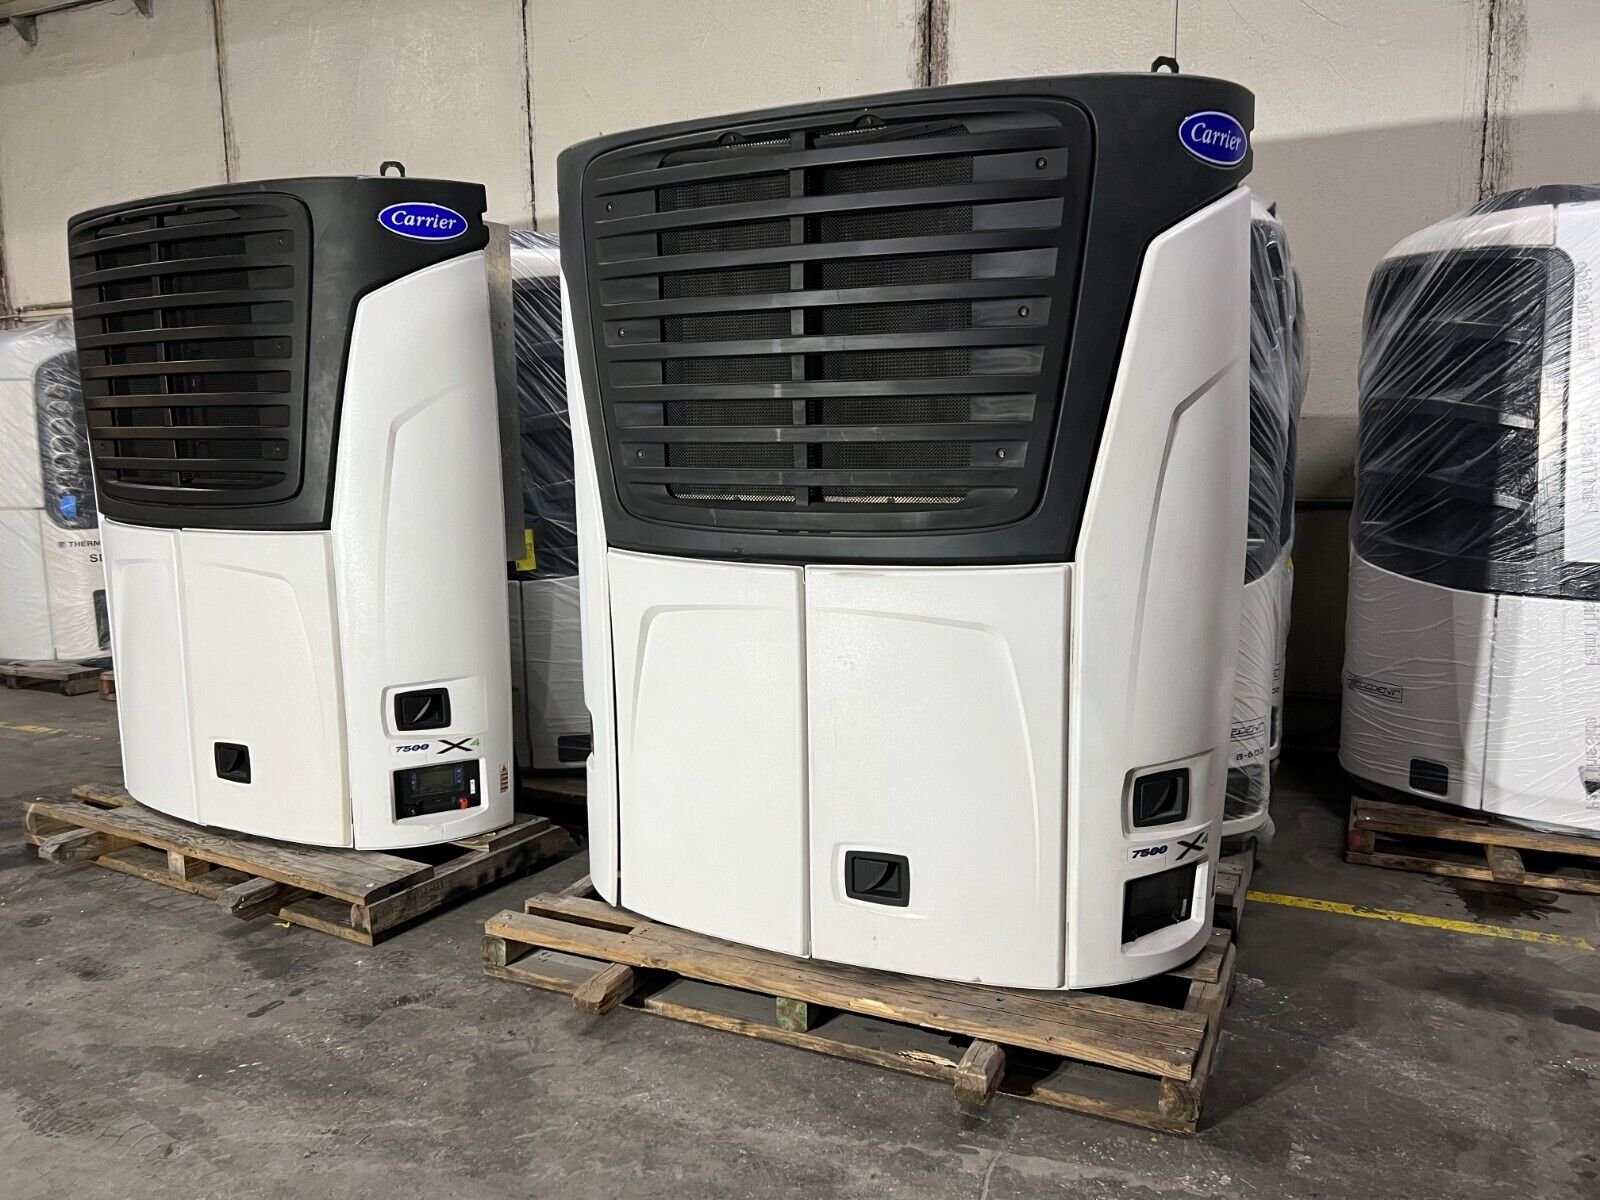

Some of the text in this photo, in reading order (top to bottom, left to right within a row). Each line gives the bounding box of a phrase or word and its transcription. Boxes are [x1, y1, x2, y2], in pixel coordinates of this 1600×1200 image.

[1191, 122, 1242, 151] Carrier
[391, 210, 457, 230] Carrier
[395, 743, 430, 753] 7500
[1132, 844, 1169, 859] 7500
